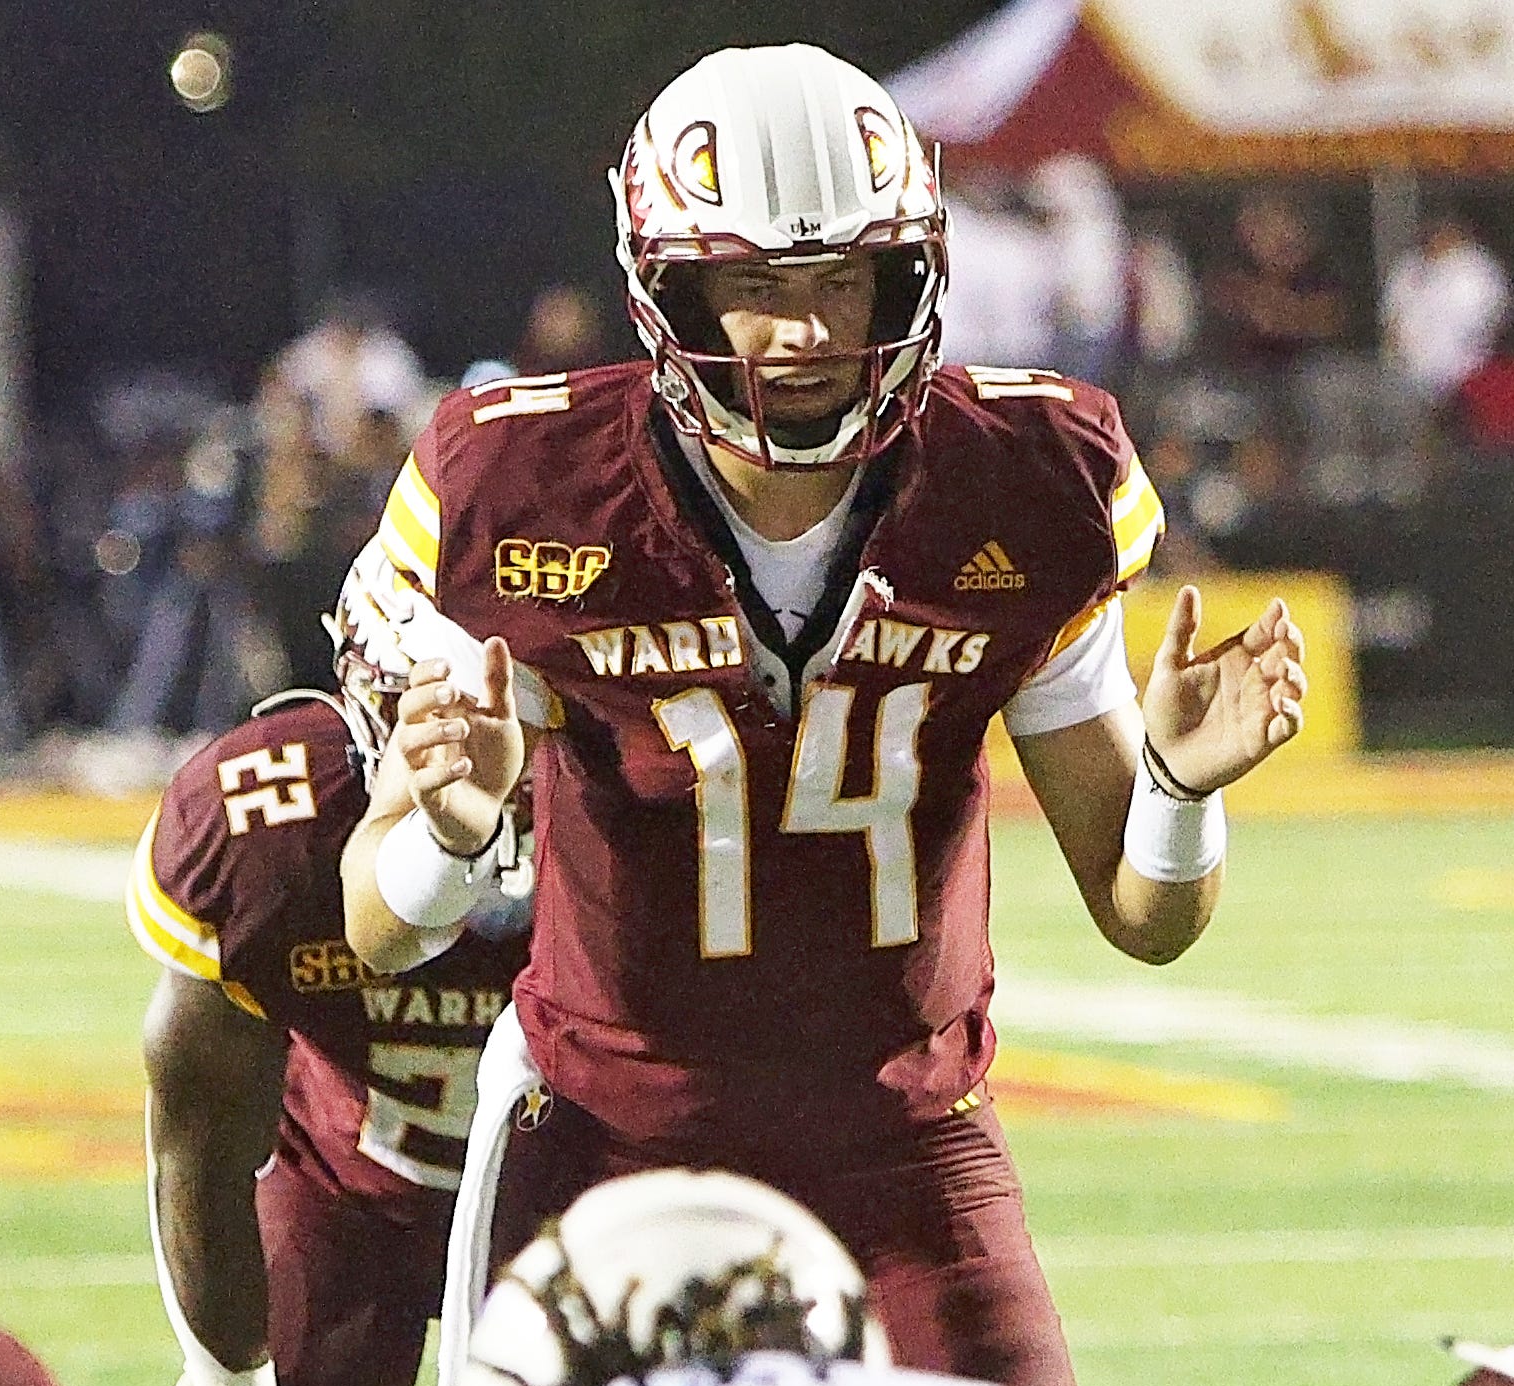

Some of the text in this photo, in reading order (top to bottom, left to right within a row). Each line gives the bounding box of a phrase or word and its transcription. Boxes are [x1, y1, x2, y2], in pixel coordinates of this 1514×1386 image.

[495, 538, 611, 600] SBC
[953, 571, 1025, 591] adidas
[217, 742, 319, 837] 22
[651, 680, 934, 960] 14
[290, 939, 396, 994] SB
[361, 986, 508, 1026] WARH
[356, 1041, 482, 1192] 2
